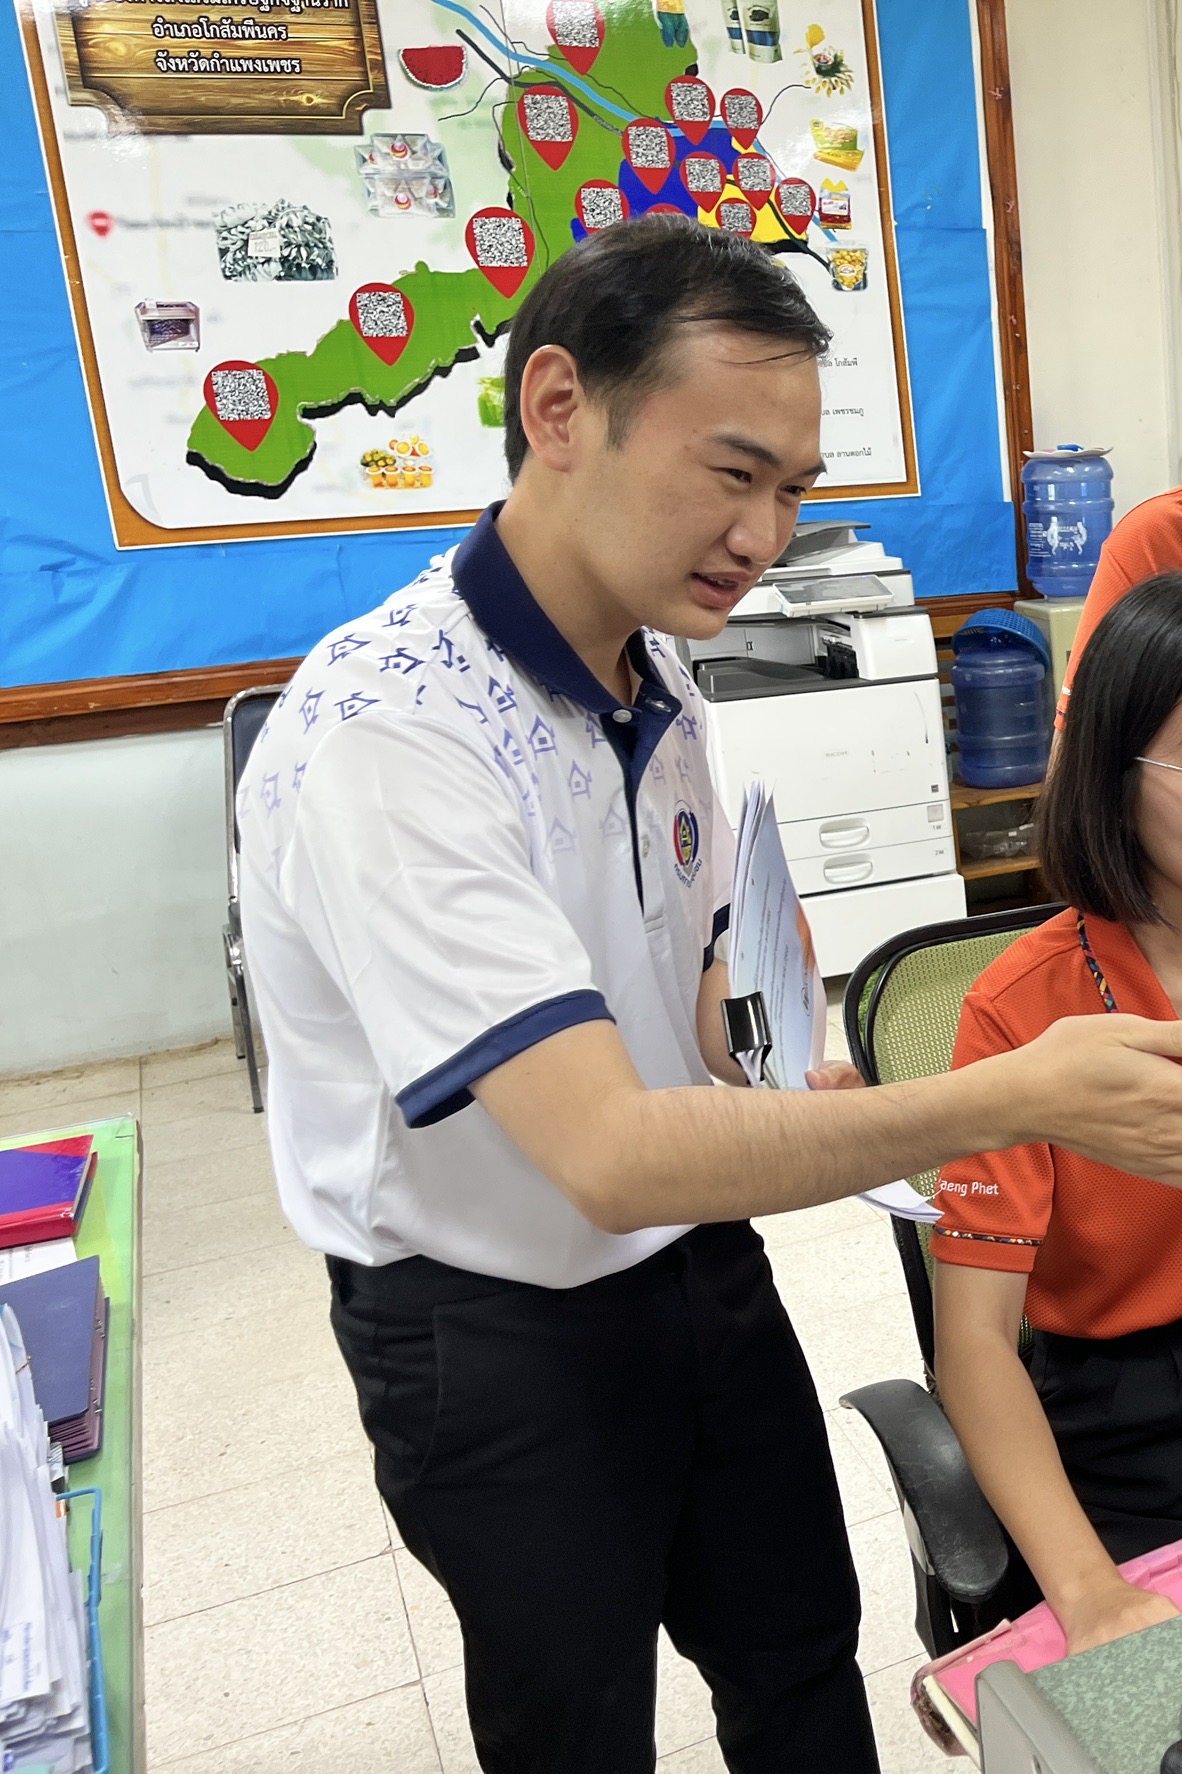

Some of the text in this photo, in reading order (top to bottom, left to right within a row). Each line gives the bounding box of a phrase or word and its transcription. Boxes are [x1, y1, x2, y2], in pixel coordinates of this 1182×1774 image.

[153, 17, 288, 39] อำเภอโกสัมพีนคร
[155, 51, 301, 73] จังหวัดกำแพงเพชร
[971, 1181, 999, 1195] Phet
